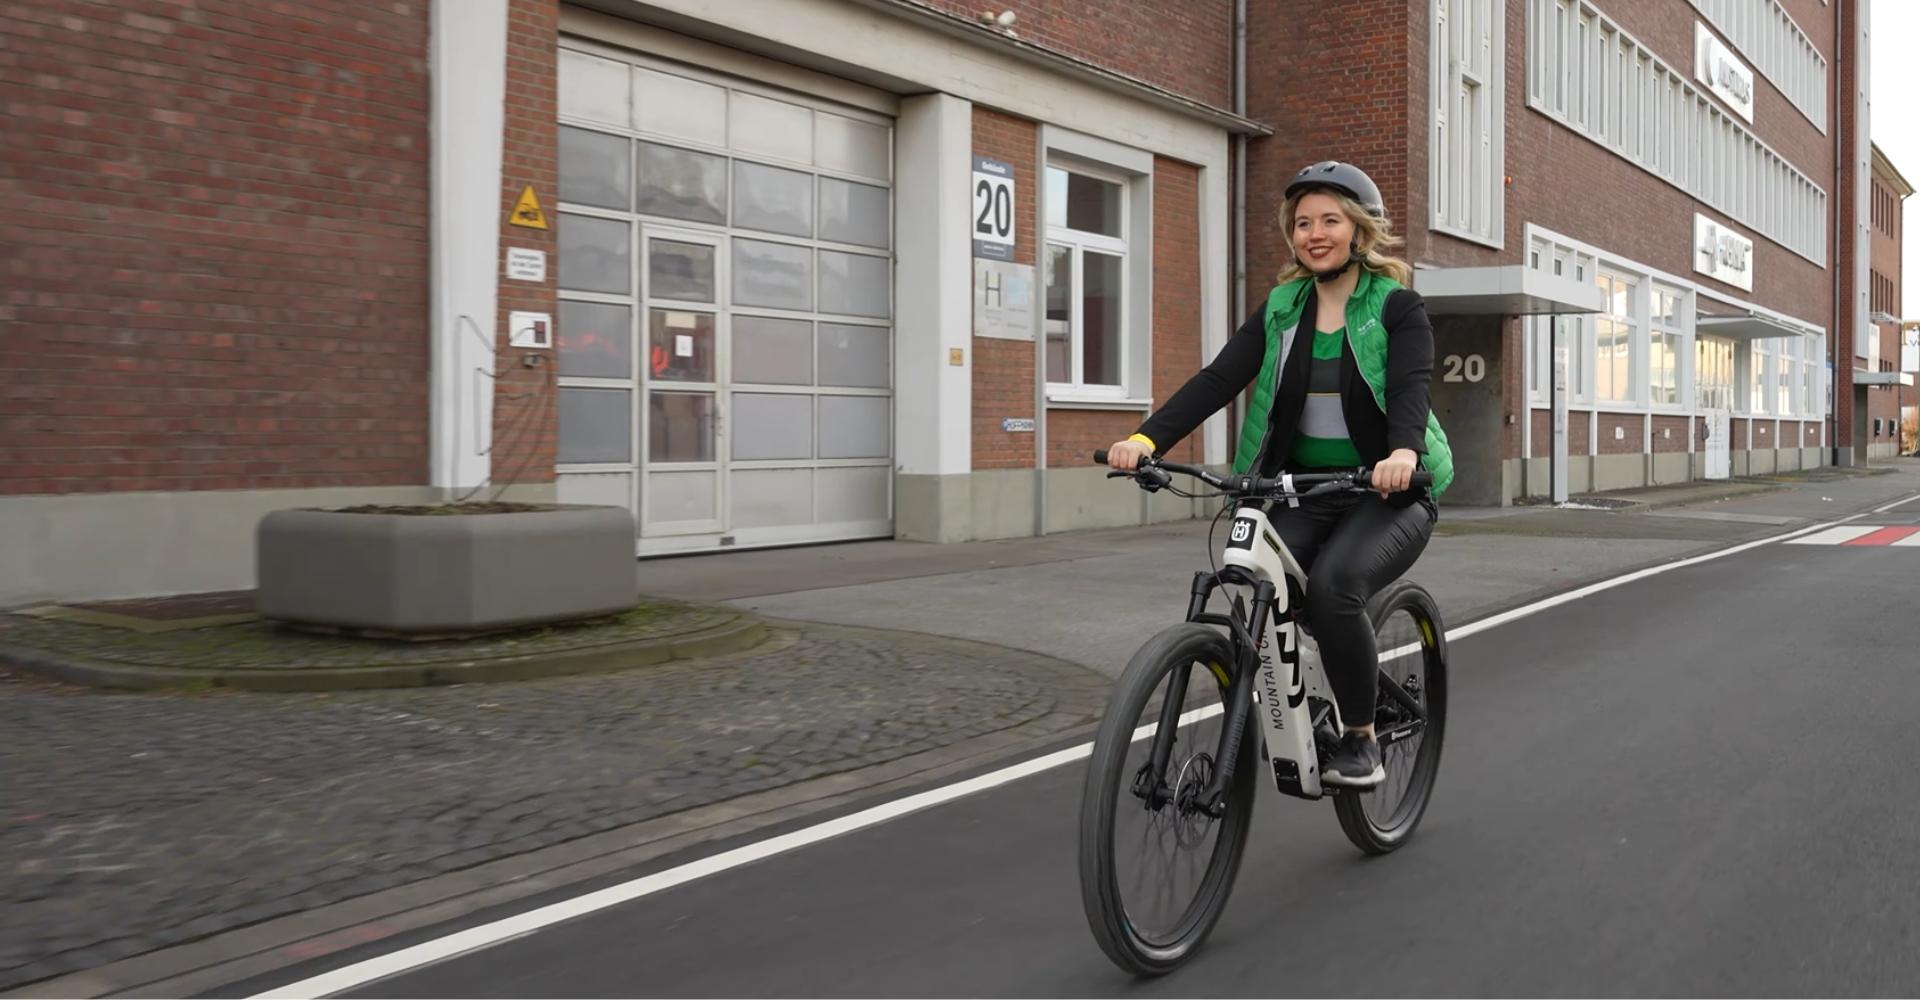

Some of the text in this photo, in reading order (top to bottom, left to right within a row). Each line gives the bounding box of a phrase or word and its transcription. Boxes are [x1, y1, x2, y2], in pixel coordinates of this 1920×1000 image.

[976, 179, 1011, 237] 20
[1443, 353, 1486, 383] 20
[1261, 654, 1284, 730] MOUNTAIN
